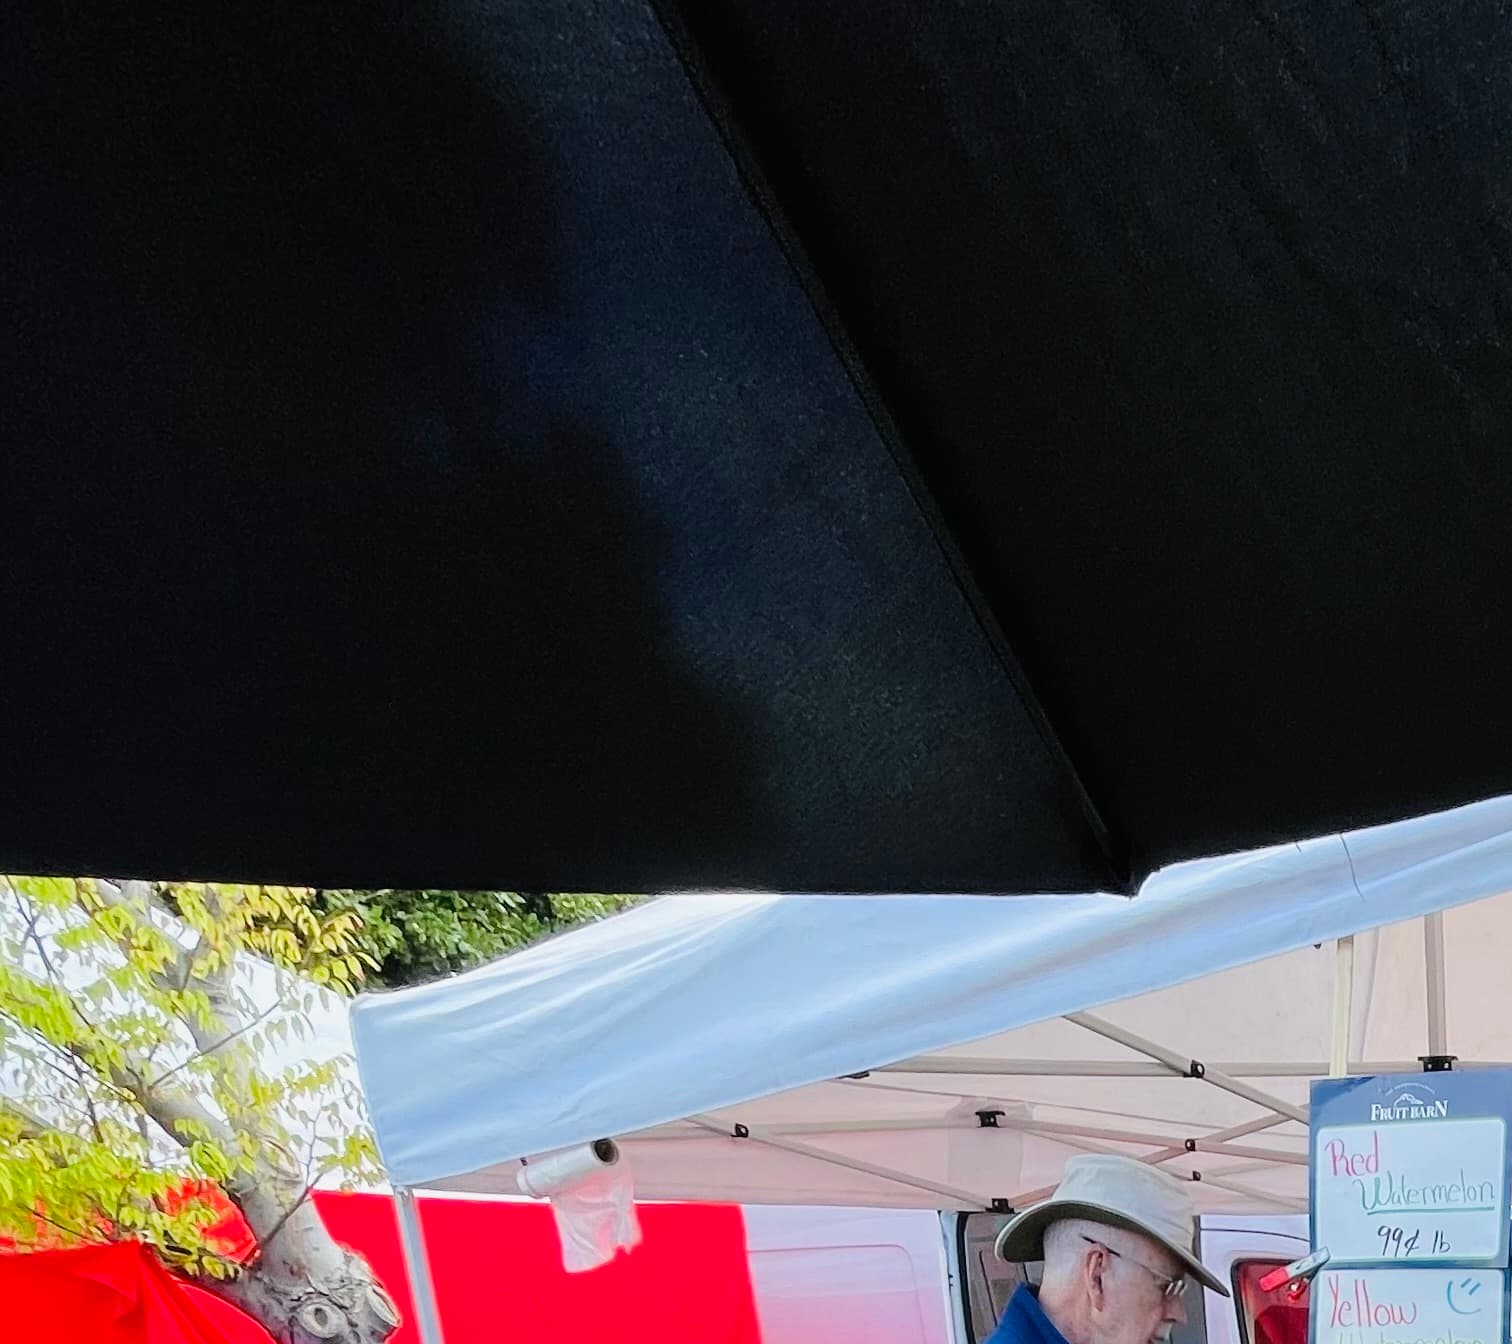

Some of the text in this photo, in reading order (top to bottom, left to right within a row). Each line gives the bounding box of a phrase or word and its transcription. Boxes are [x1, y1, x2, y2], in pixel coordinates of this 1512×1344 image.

[1370, 1099, 1448, 1121] FRUIT BARN
[1324, 1131, 1379, 1177] Red
[1353, 1168, 1495, 1211] Watermelon
[1377, 1225, 1451, 1258] 99¢ lb
[1328, 1275, 1418, 1329] Yellow
